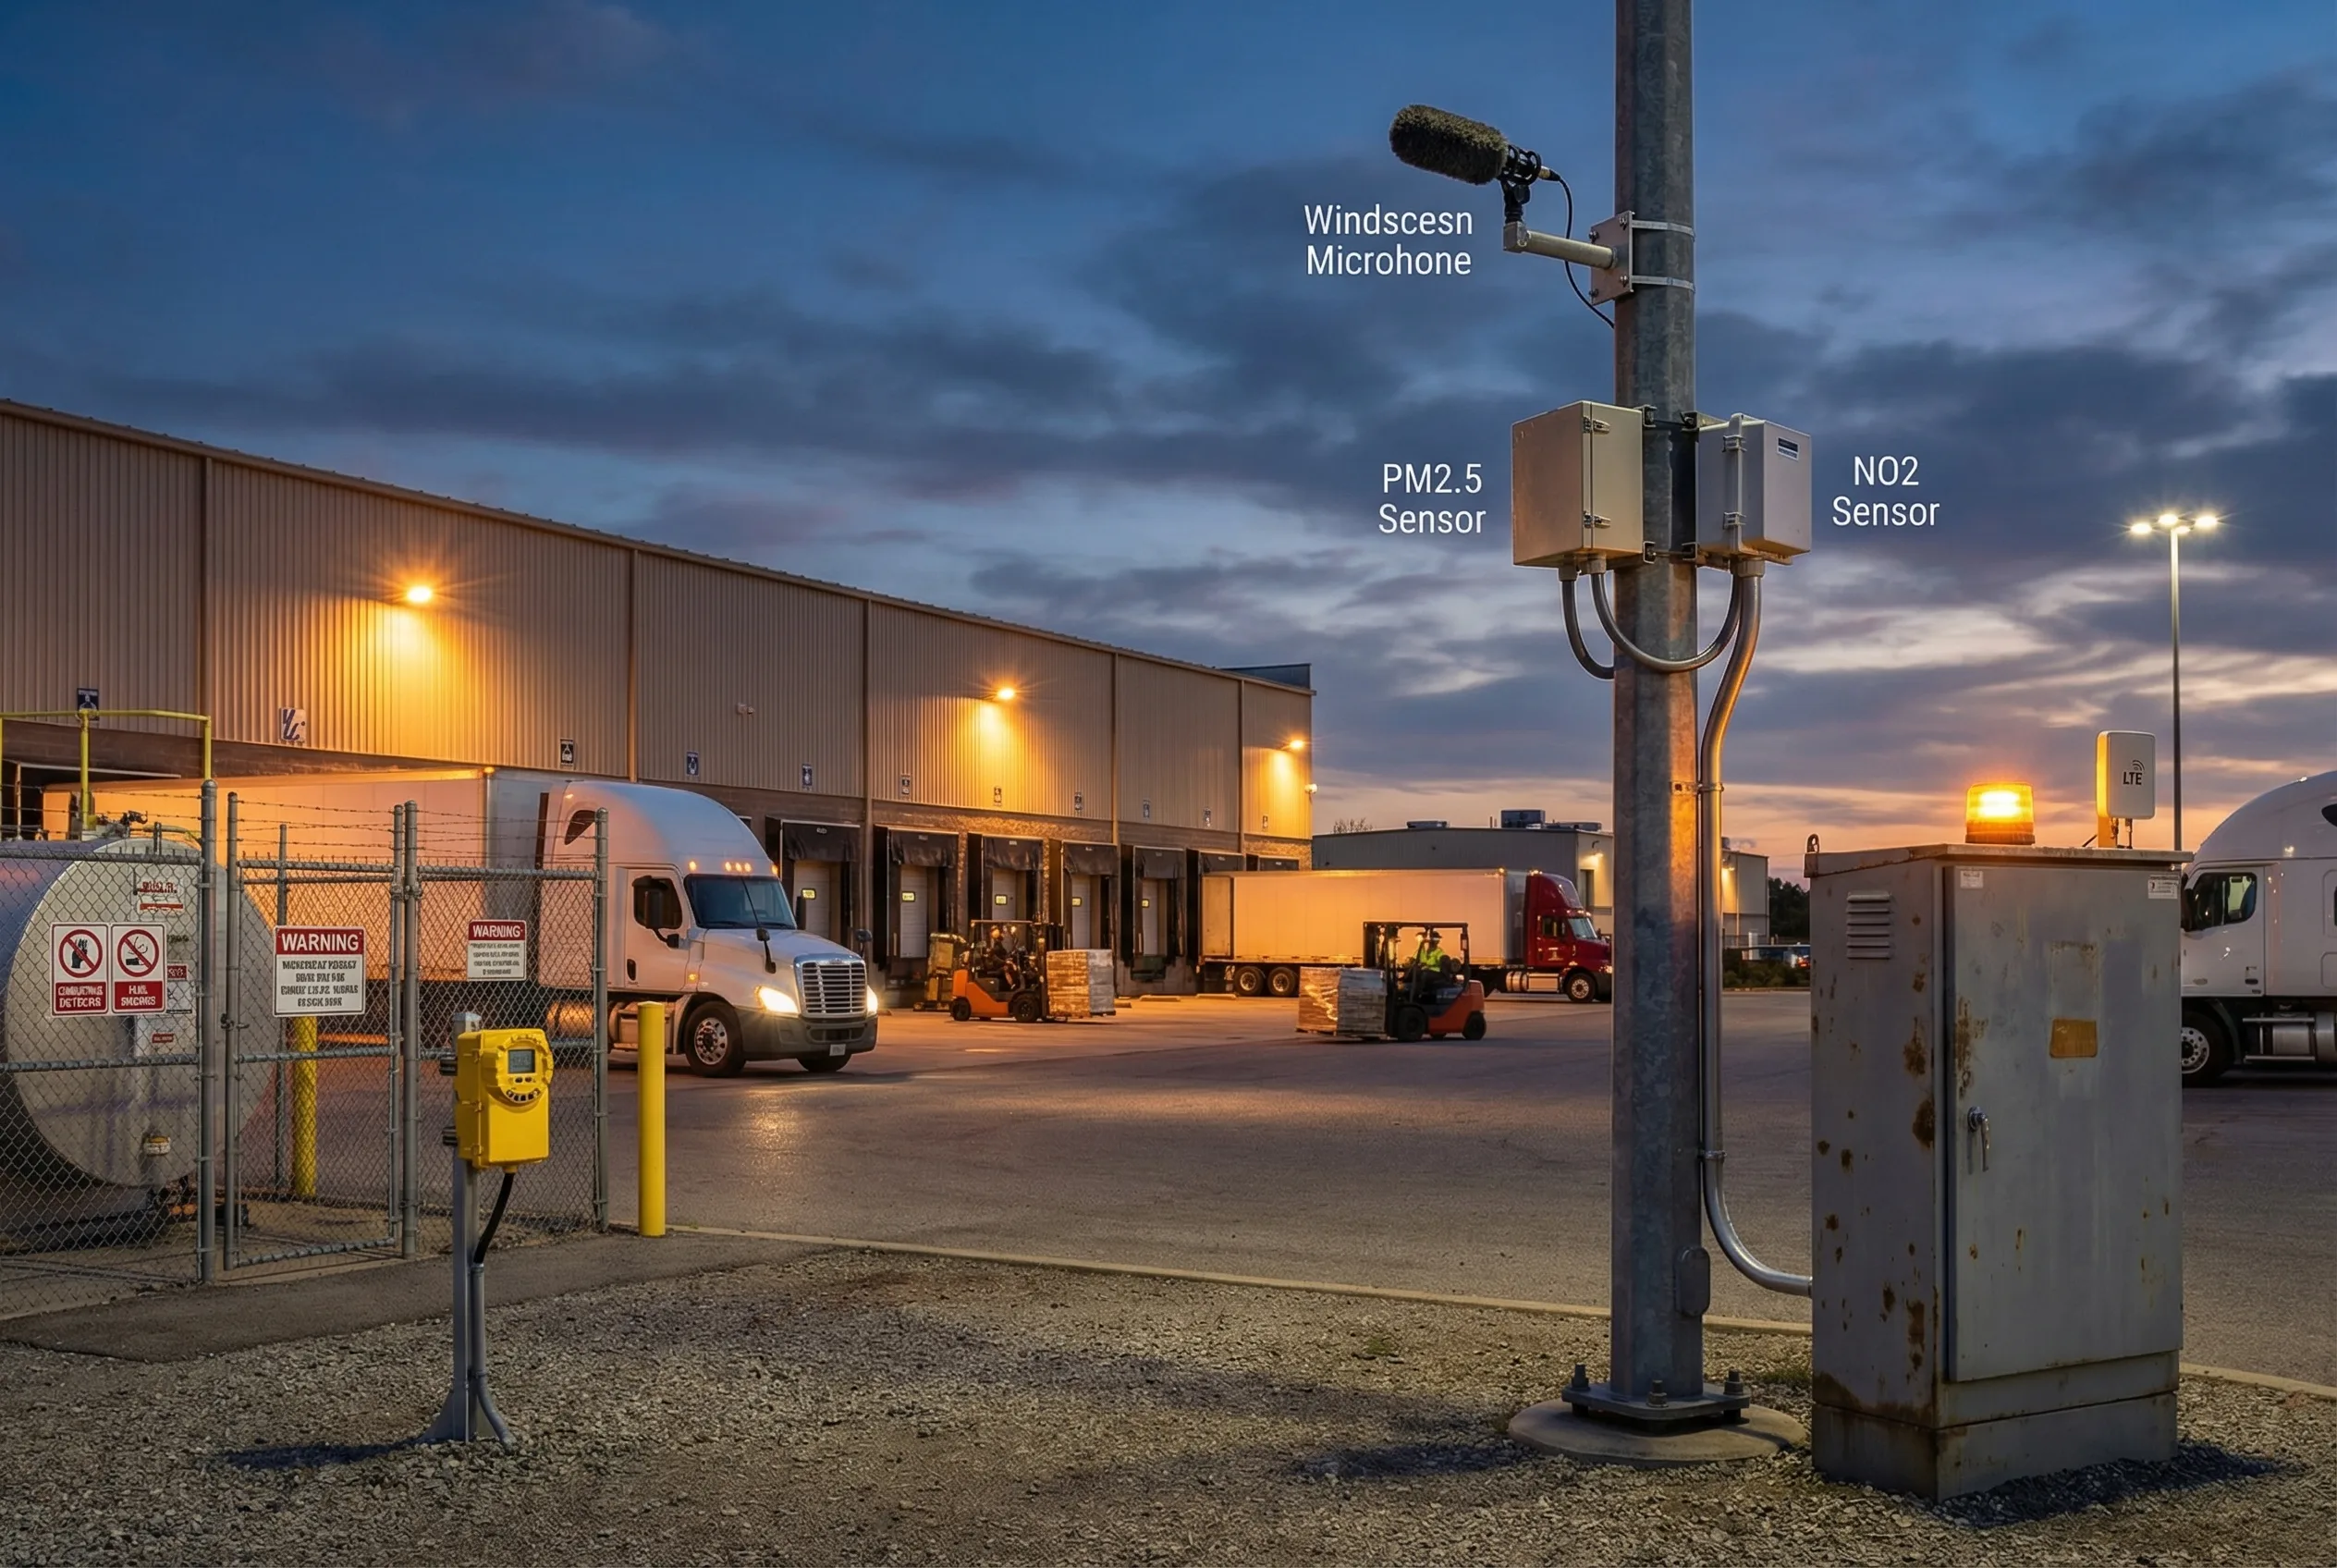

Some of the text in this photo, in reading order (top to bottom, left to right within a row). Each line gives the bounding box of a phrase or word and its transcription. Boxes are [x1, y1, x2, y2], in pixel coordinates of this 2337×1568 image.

[2123, 771, 2143, 786] LTE
[472, 925, 521, 938] WARNING
[281, 933, 360, 951] WARNING
